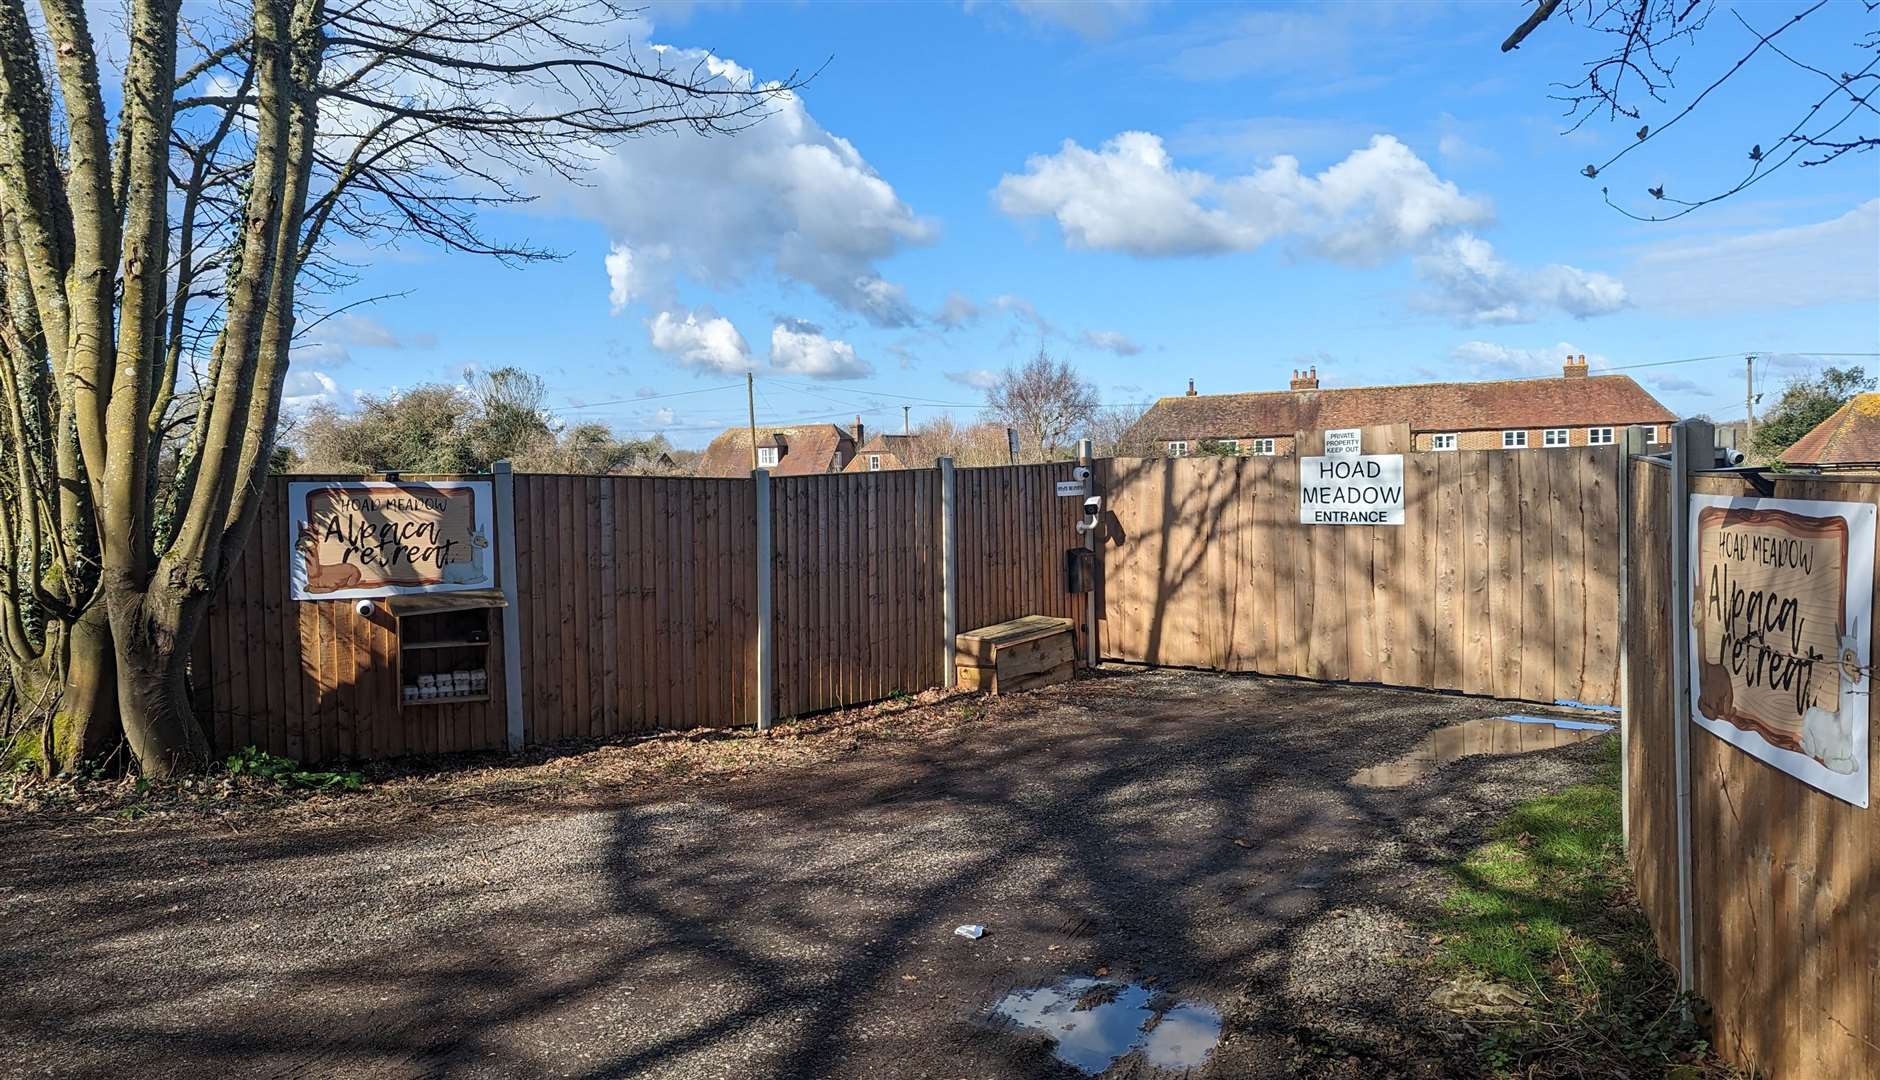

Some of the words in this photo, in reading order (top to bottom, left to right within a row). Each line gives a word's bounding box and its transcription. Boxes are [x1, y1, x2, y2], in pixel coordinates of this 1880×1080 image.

[1320, 461, 1380, 479] HOAD
[1303, 486, 1401, 504] MEADOW
[341, 499, 380, 512] HOAD
[386, 498, 448, 512] MEADOW
[1315, 511, 1388, 522] ENTRANCE
[324, 514, 441, 548] Alpaca
[1719, 531, 1748, 562] HOAD
[1752, 535, 1814, 575] MEADOW
[1708, 563, 1804, 651] Alpaca
